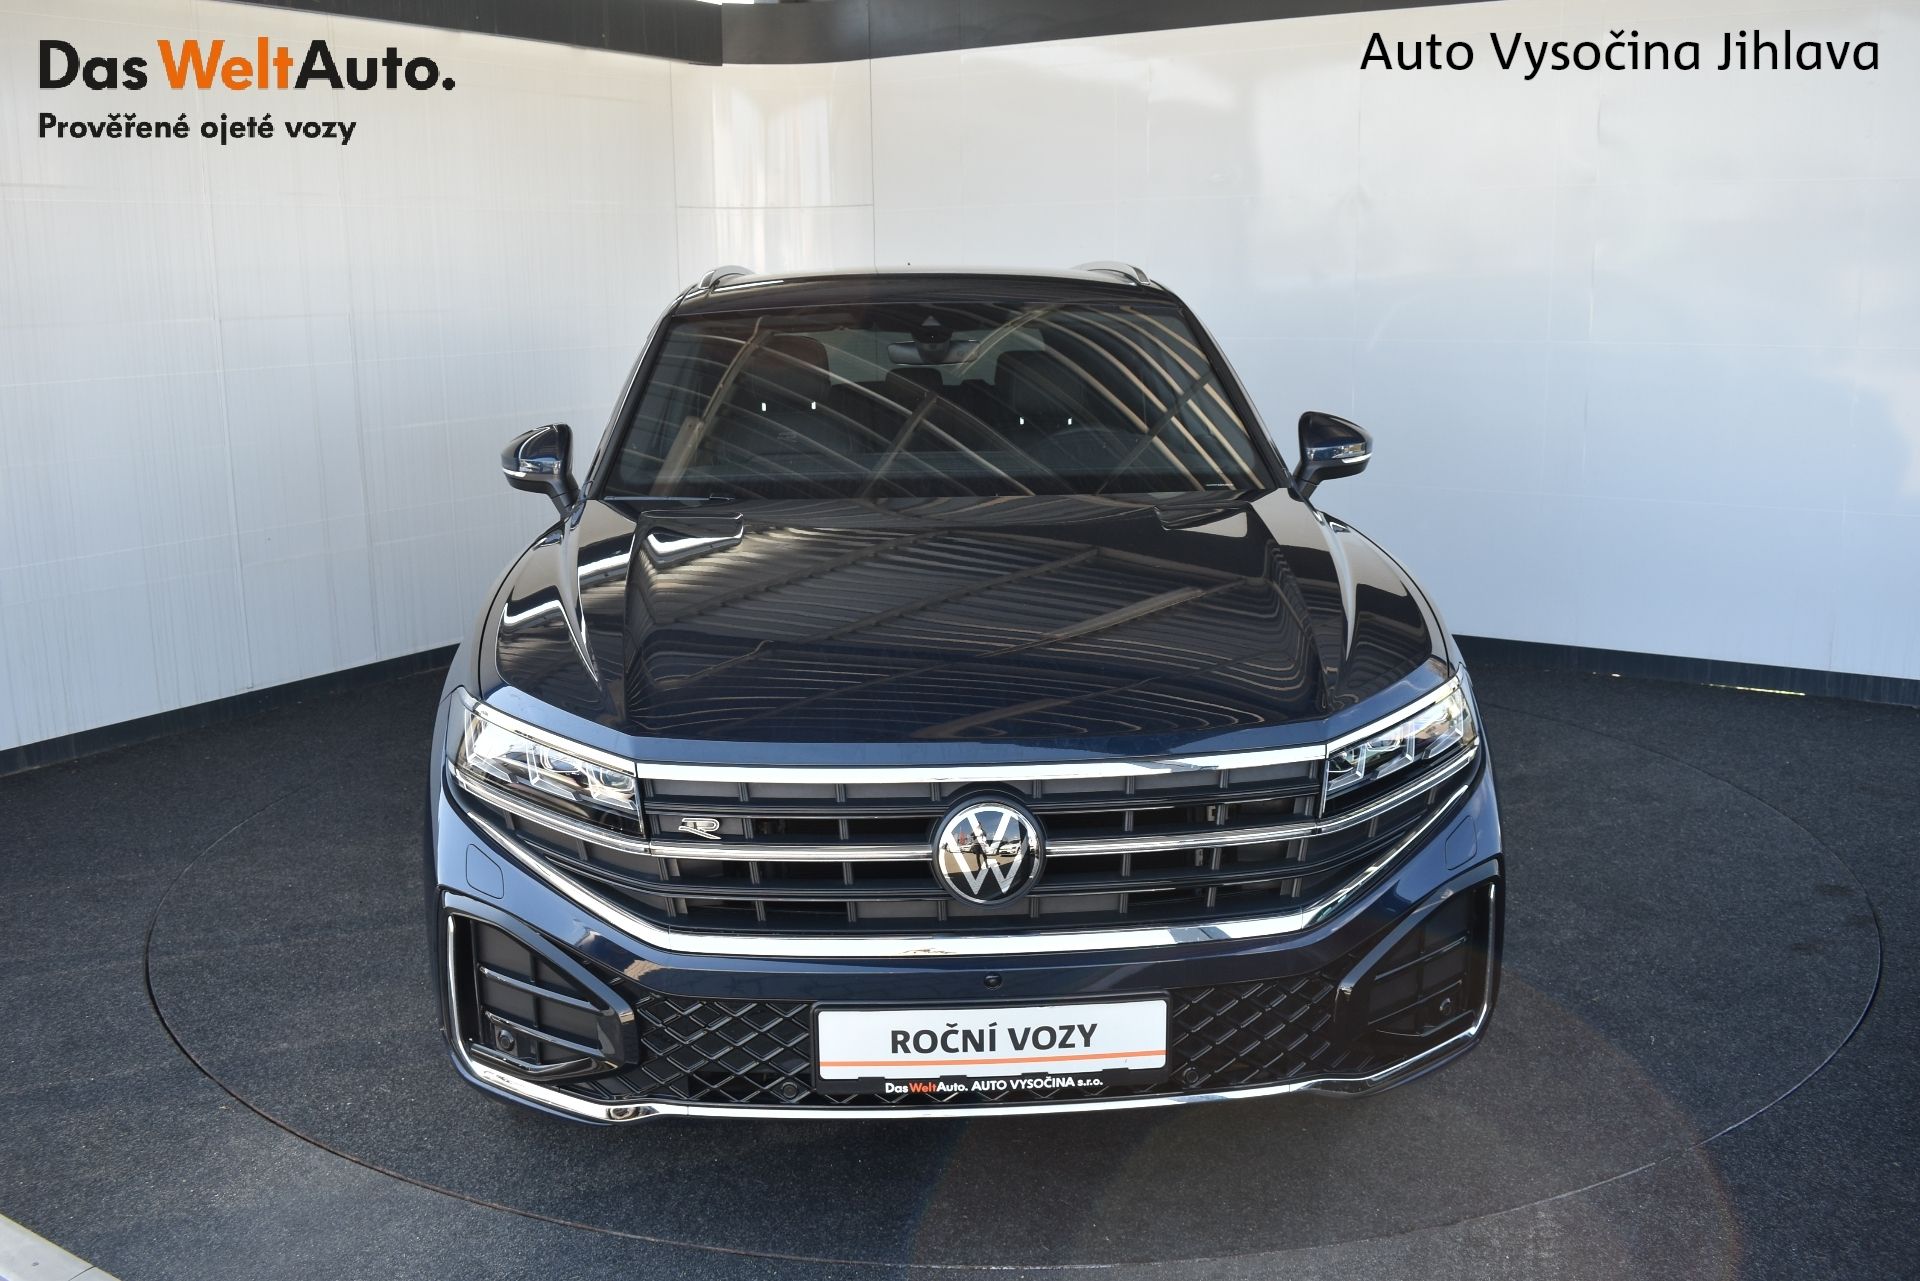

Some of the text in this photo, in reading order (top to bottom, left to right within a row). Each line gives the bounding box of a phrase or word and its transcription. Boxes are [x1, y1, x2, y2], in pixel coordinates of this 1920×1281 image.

[891, 1021, 1098, 1054] ROČNÍ VOZY
[971, 1080, 1007, 1092] AUTO
[1009, 1076, 1076, 1090] VYSOČINA
[1077, 1078, 1104, 1088] s.r.o.
